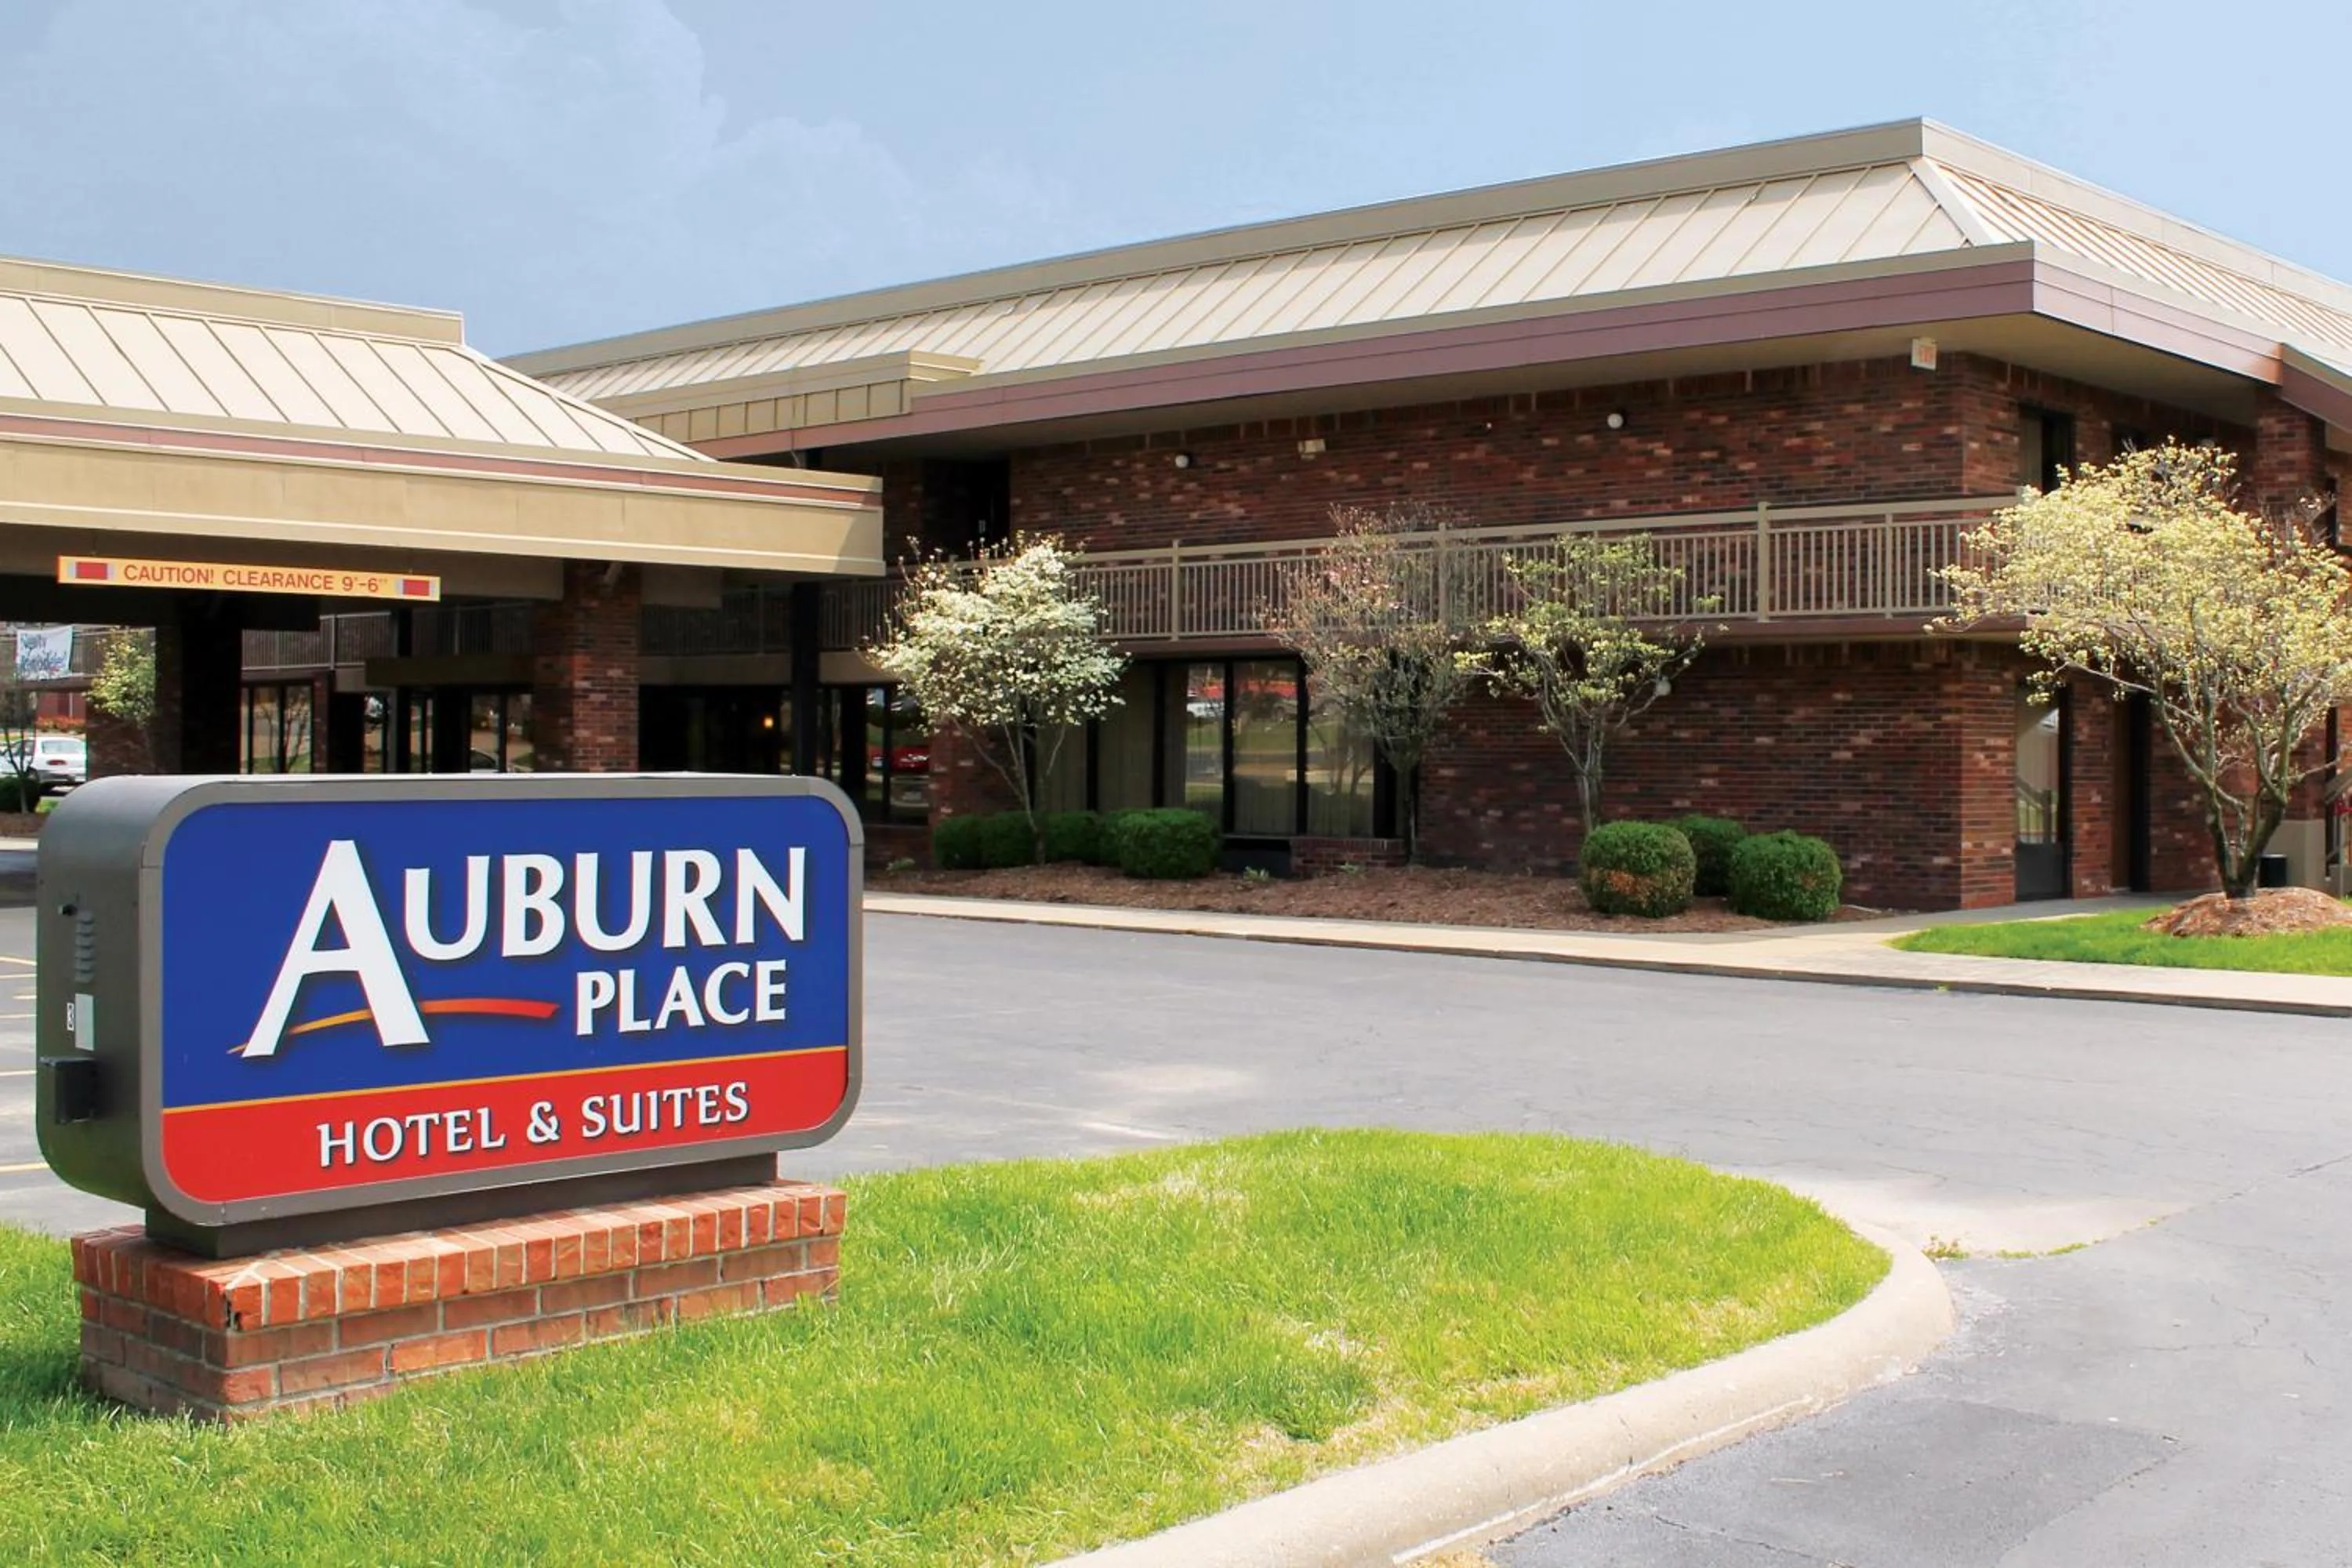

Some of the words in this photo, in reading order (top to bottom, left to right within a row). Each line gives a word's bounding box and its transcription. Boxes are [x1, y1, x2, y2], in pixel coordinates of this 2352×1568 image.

[124, 564, 214, 584] CAUTION!
[223, 569, 334, 590] CLEARANCE
[242, 840, 805, 1057] AUBURN
[576, 959, 786, 1036] PLACE
[317, 1107, 506, 1167] HOTEL
[527, 1102, 560, 1143] &
[582, 1082, 748, 1138] SUITES
